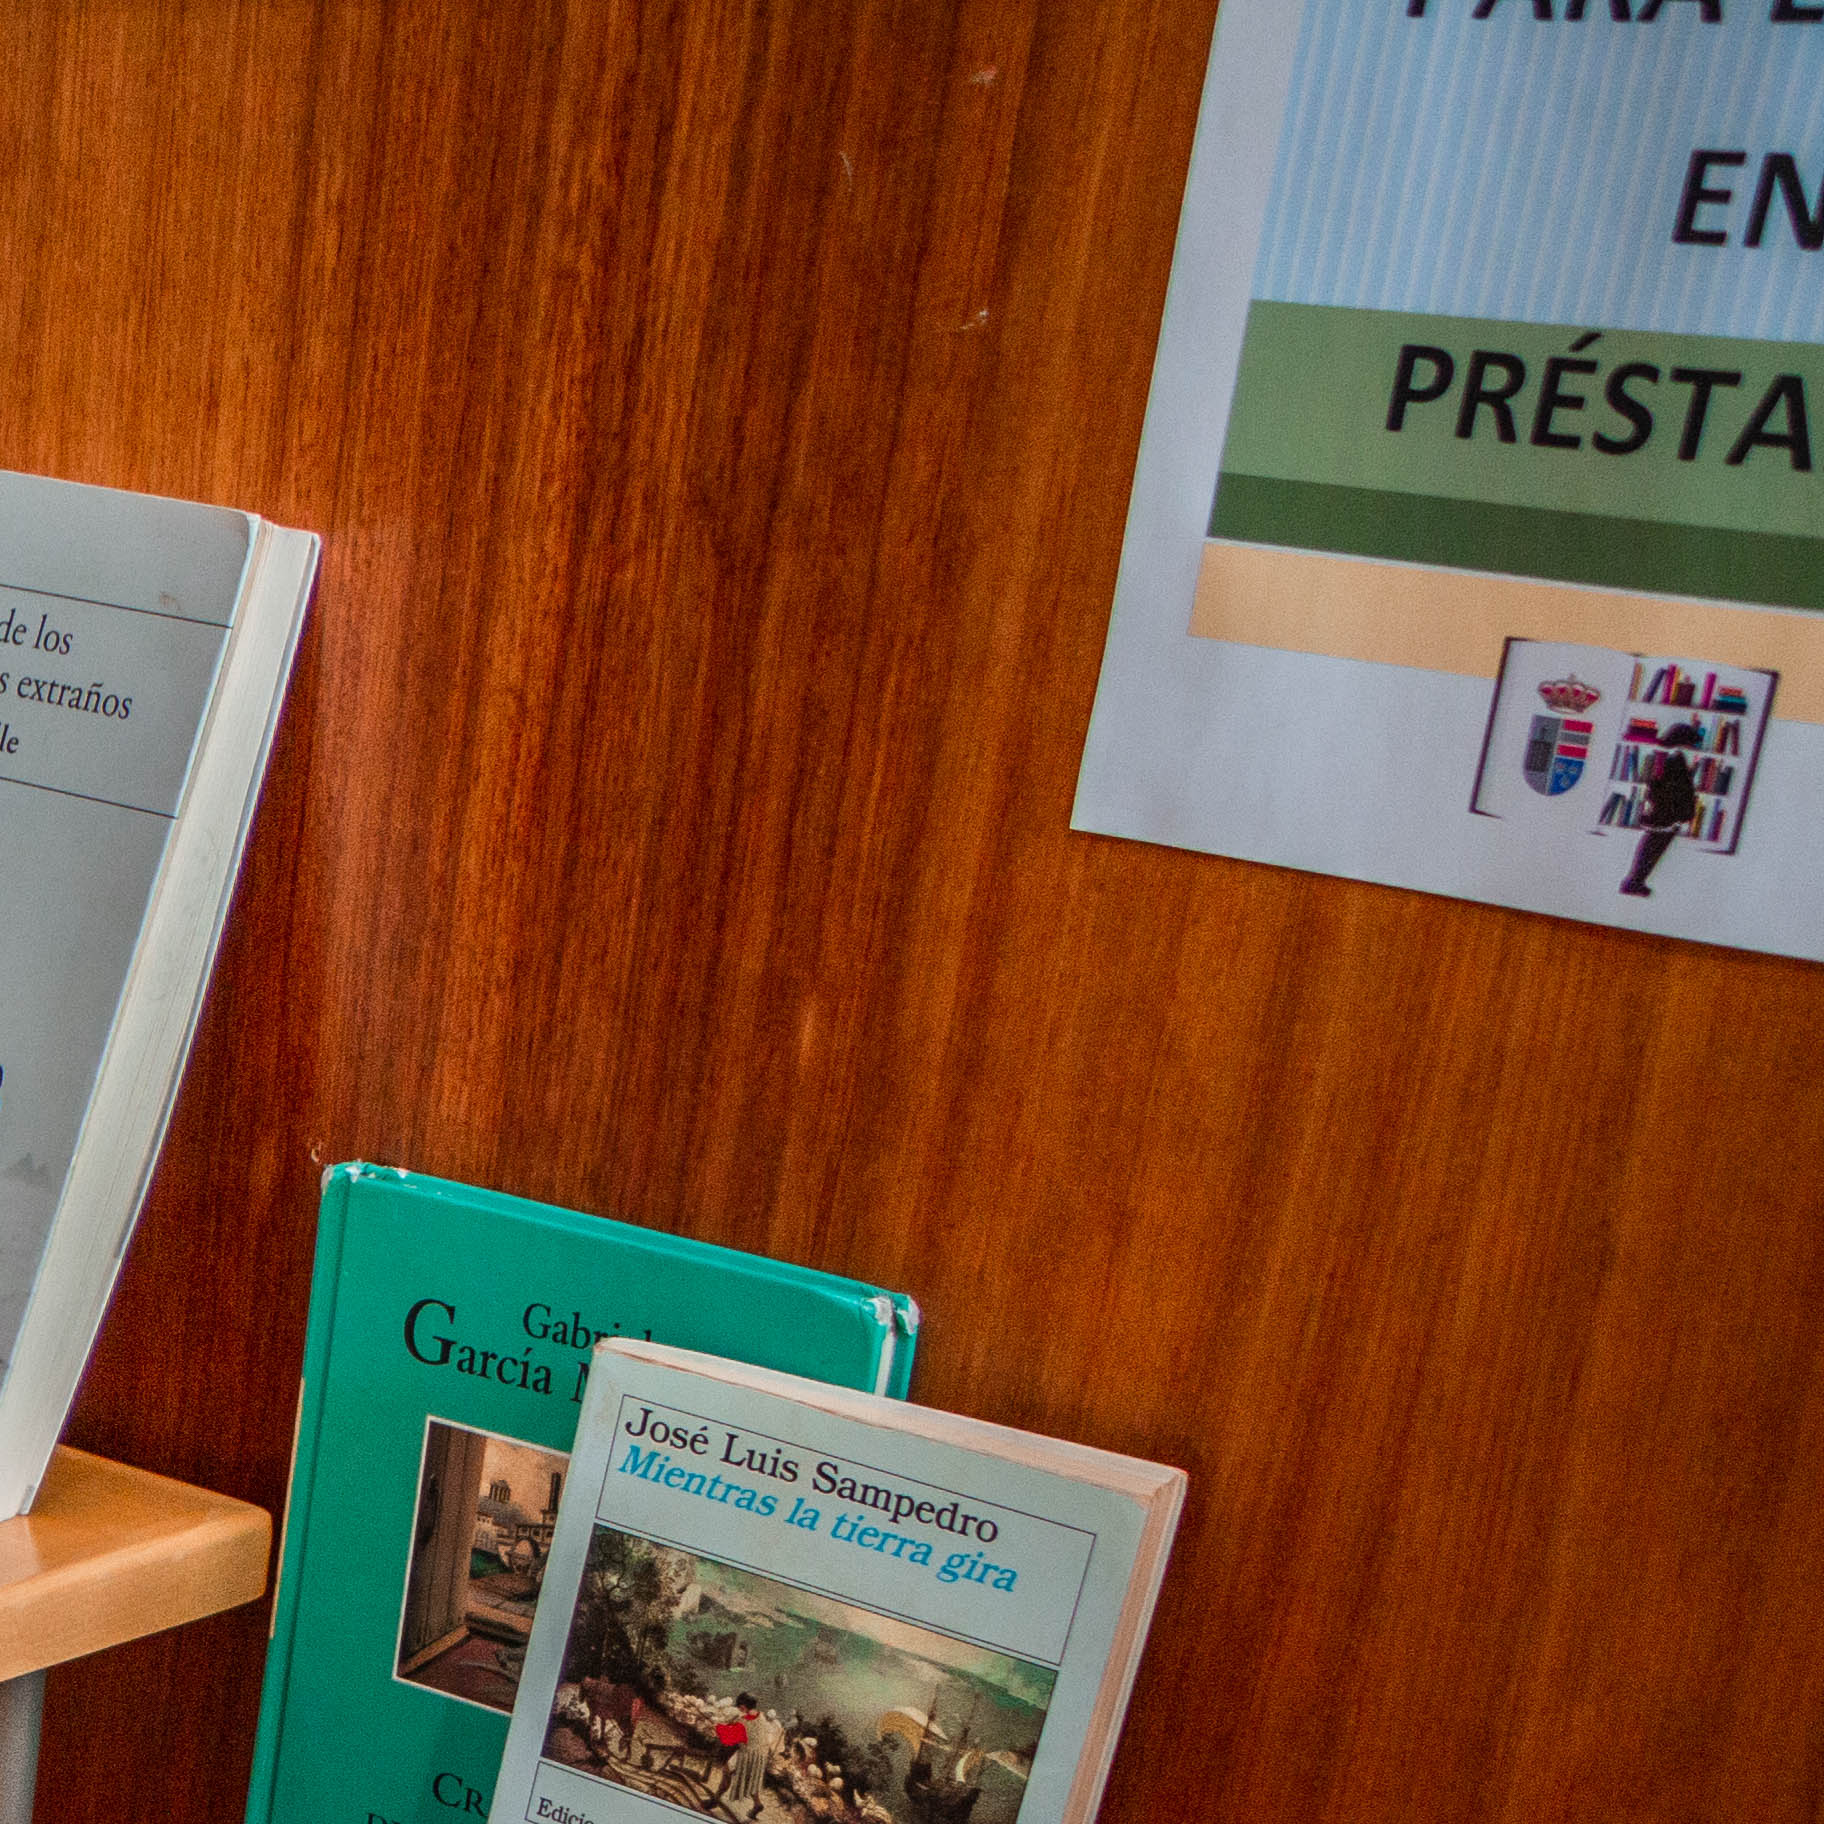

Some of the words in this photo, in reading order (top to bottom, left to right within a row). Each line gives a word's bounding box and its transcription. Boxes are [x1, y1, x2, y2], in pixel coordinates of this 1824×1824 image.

[33, 614, 74, 656] los
[16, 679, 133, 721] extraños
[403, 1297, 554, 1397] García
[617, 1443, 777, 1519] Mientras
[783, 1496, 821, 1533] la
[828, 1511, 935, 1569] tierra
[935, 1548, 1021, 1594] gira
[624, 1406, 709, 1456] José
[719, 1431, 800, 1484] Luis
[810, 1460, 1001, 1545] Sampedro
